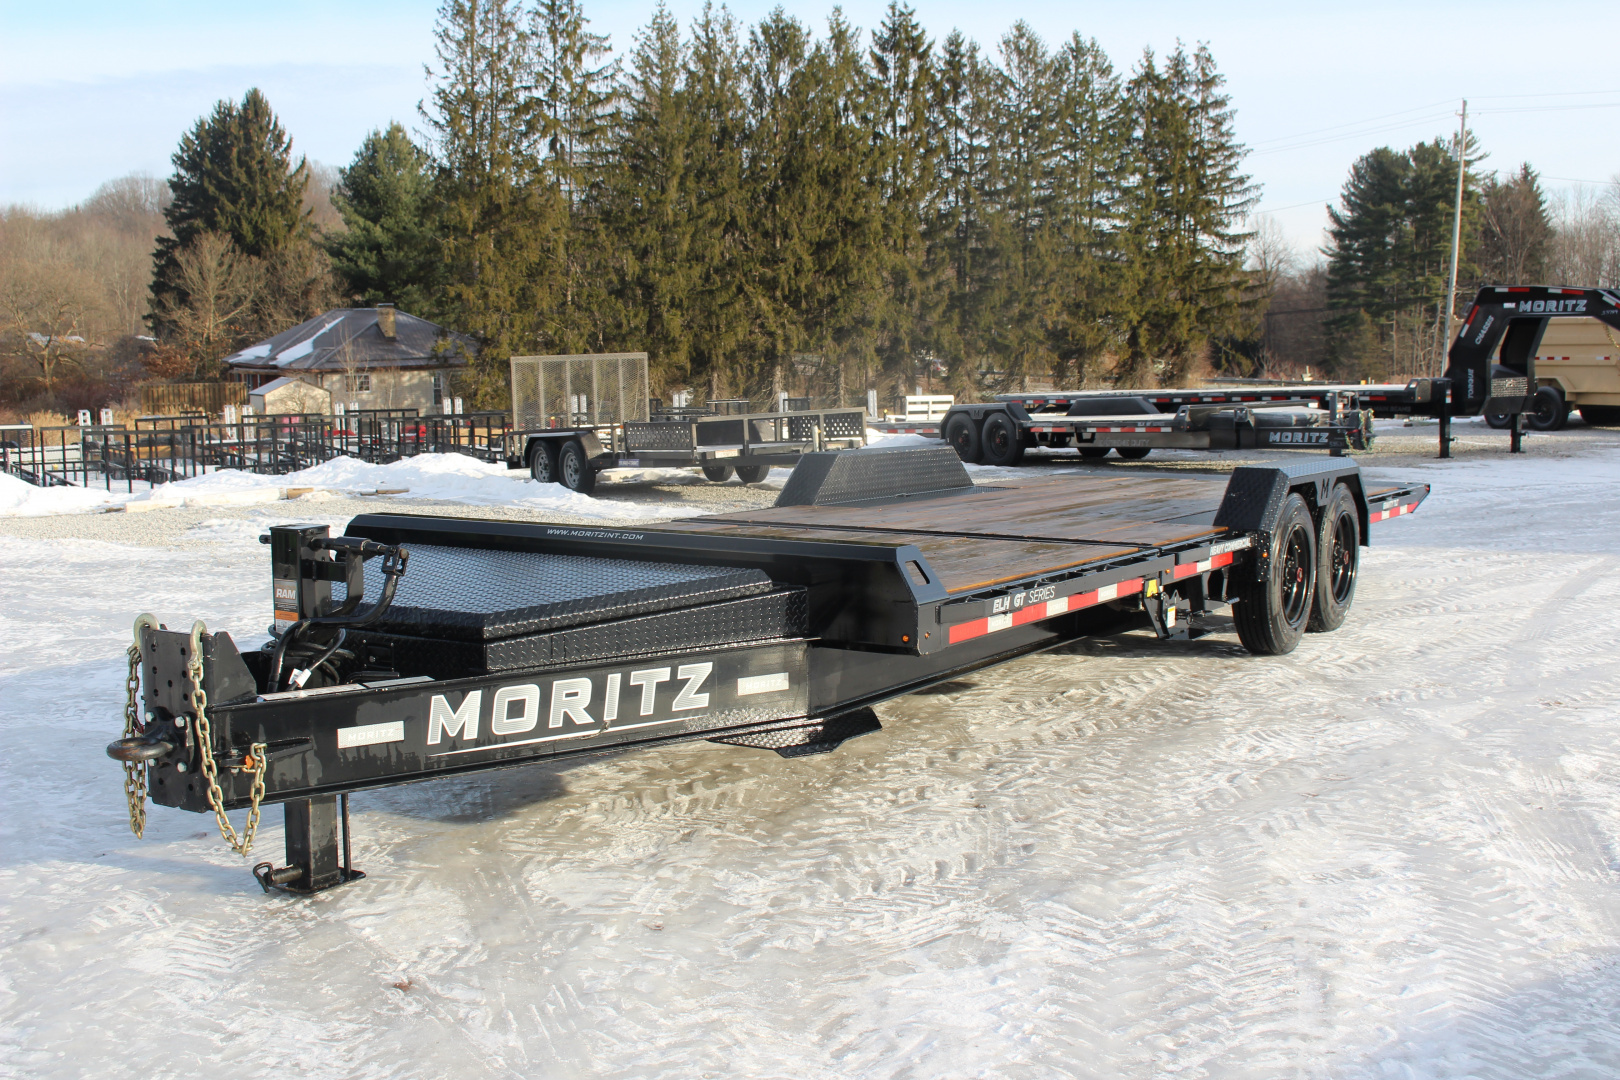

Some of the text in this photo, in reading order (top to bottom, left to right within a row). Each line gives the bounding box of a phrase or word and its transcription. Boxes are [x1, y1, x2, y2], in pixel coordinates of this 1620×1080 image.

[1519, 299, 1587, 313] MORITZ
[1475, 315, 1495, 345] CHASSIS
[1269, 431, 1330, 443] MORITZ
[547, 528, 644, 541] WWW.MORITZINT.COM
[276, 588, 297, 600] RAM
[993, 585, 1056, 614] ELH GT SERIES
[746, 679, 782, 691] MORITZ
[427, 662, 713, 746] MORITZ
[348, 728, 394, 742] MORITZ
